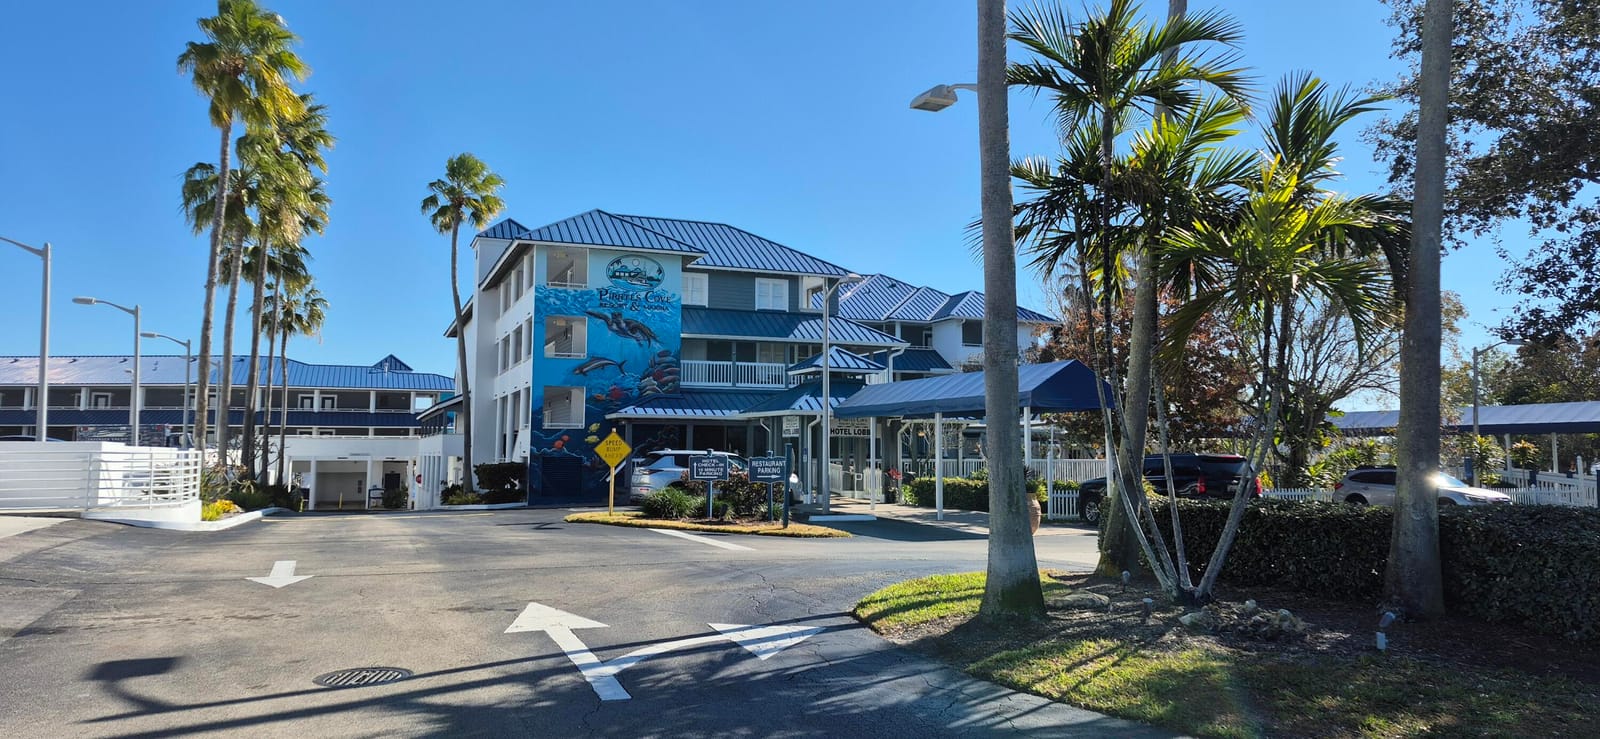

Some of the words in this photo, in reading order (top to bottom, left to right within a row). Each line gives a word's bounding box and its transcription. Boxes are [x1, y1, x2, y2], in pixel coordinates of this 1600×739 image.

[644, 290, 671, 304] COVE
[629, 301, 641, 312] &
[853, 428, 871, 436] LOBB
